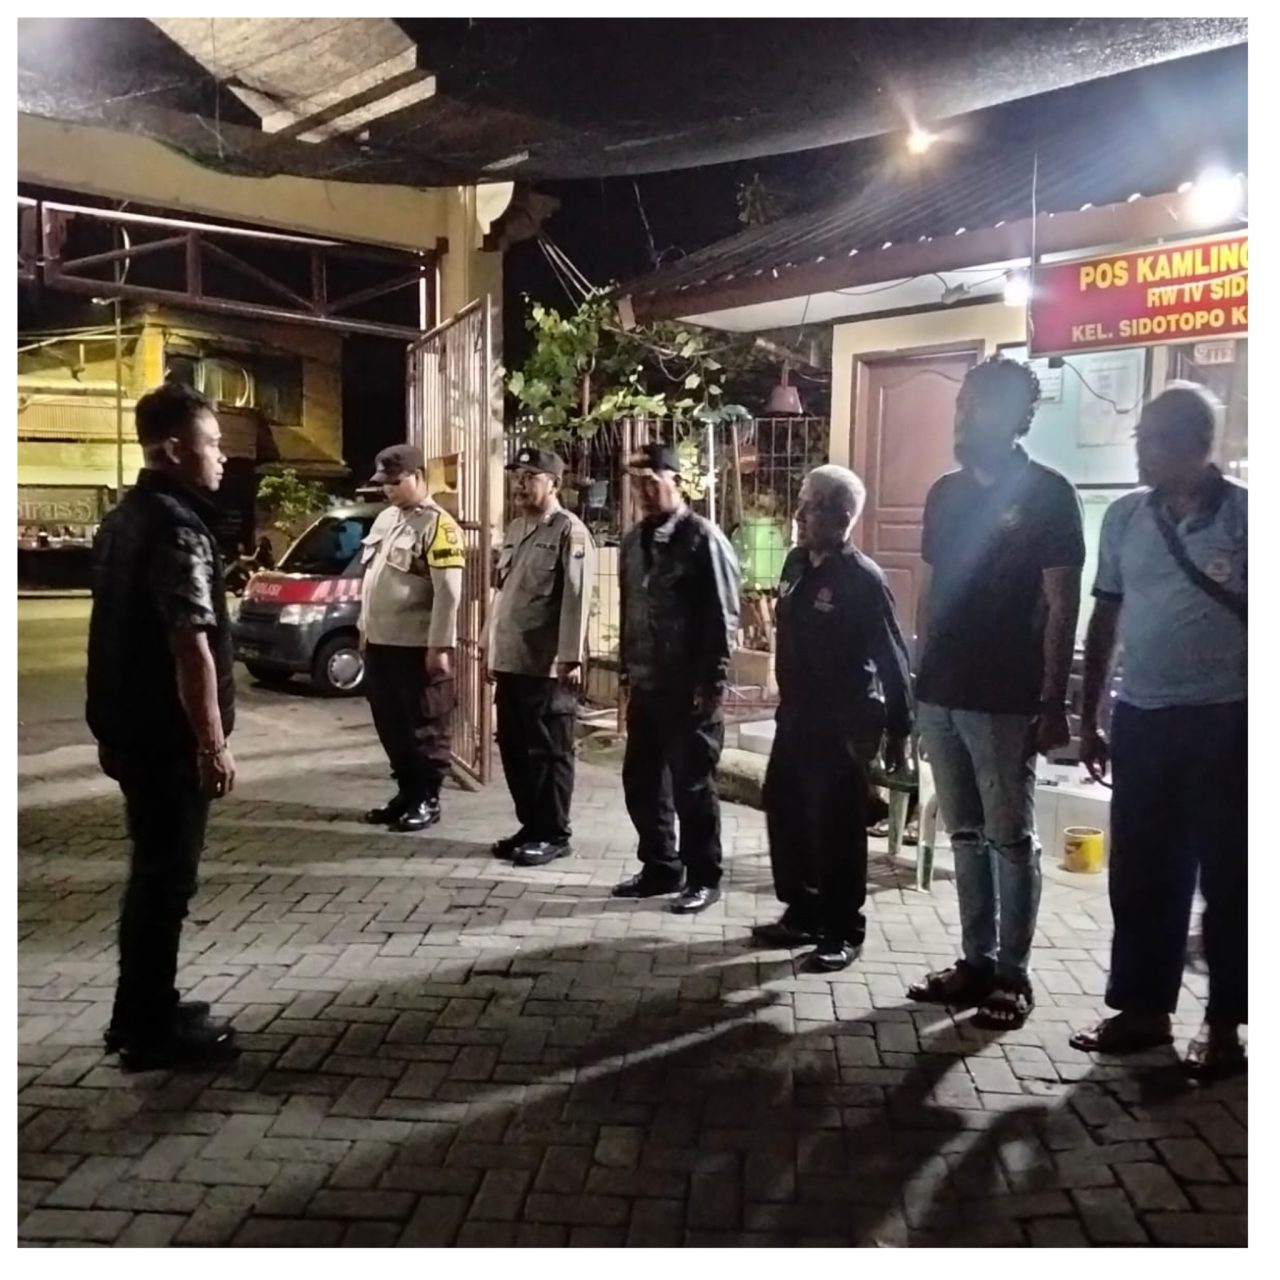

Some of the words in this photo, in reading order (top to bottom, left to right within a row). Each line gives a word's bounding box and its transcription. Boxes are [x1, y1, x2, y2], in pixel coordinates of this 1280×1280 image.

[1080, 260, 1129, 292] POS
[1147, 286, 1178, 308] RW
[1183, 283, 1204, 303] IV
[1209, 275, 1248, 301] SID
[1071, 324, 1113, 343] KEL.
[1118, 309, 1225, 338] SIDOTOPO
